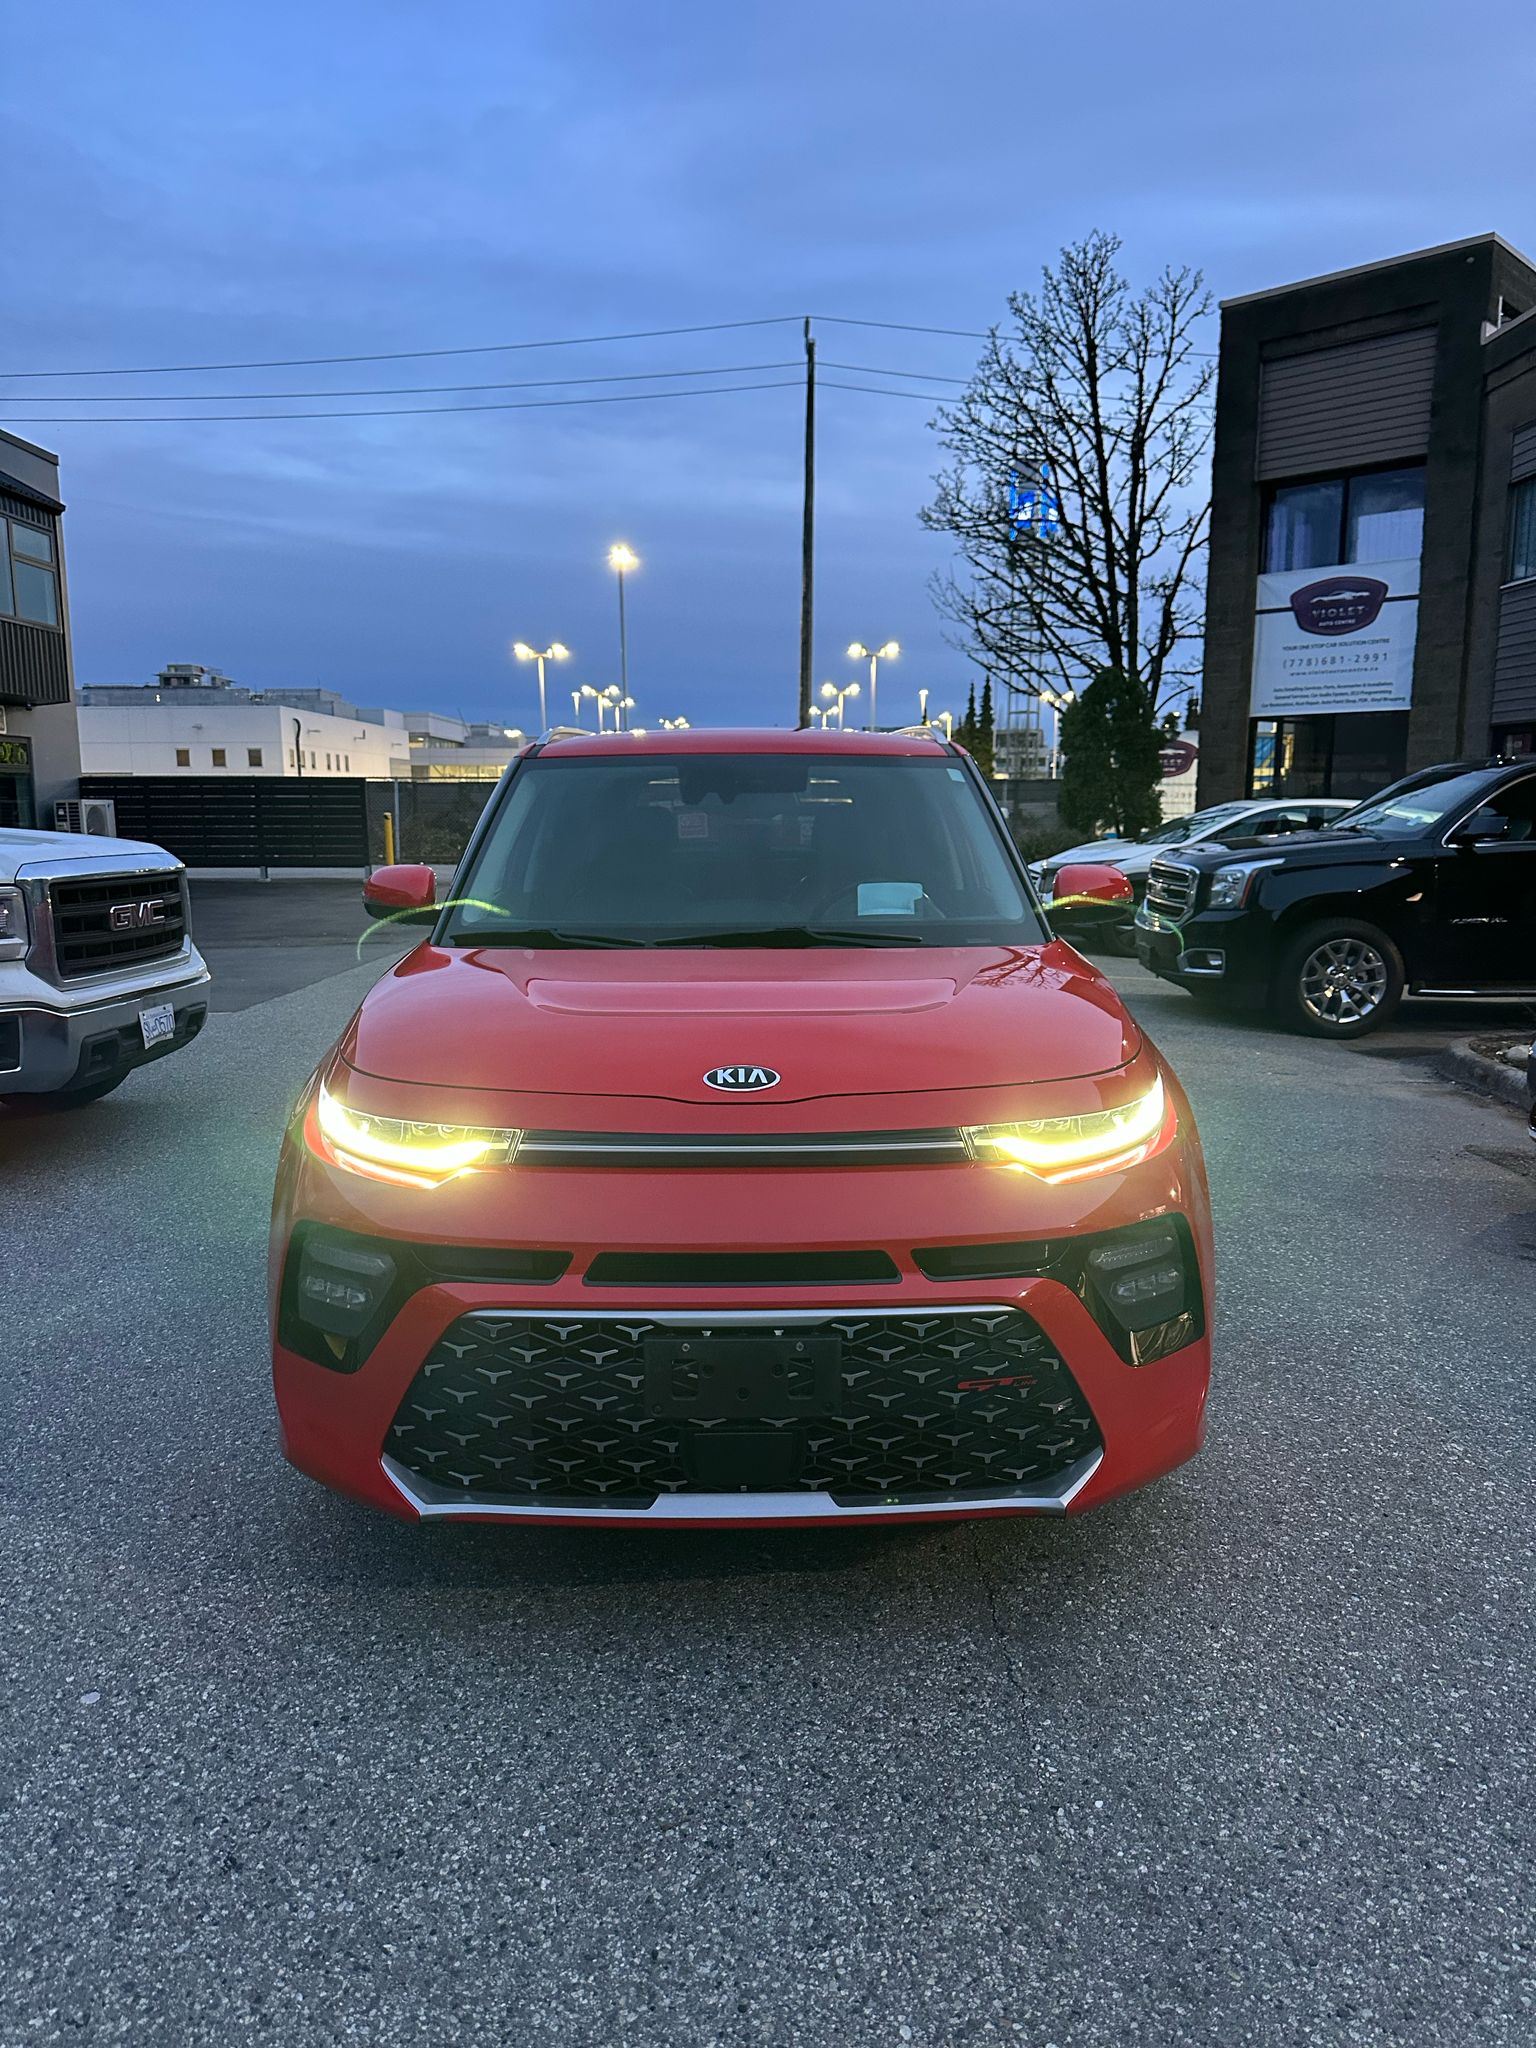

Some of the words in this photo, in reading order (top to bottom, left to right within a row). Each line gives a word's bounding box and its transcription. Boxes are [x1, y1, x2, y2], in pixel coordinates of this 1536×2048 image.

[1312, 606, 1366, 618] VIOLET
[1283, 653, 1388, 669] (778)681-2991
[110, 900, 165, 931] GMC
[717, 1068, 768, 1084] KIA
